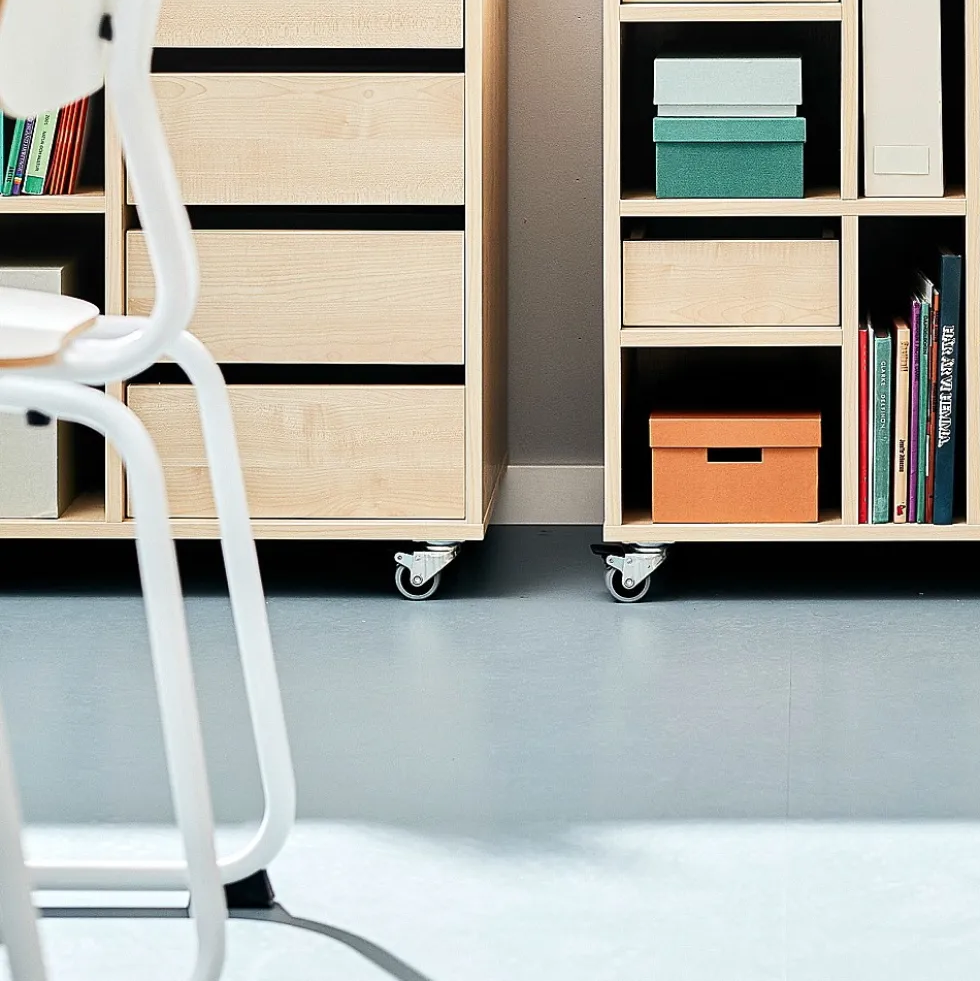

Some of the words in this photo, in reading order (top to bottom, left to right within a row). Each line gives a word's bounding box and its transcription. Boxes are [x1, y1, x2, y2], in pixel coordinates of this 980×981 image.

[942, 325, 956, 355] HÄR
[940, 356, 955, 376] ÄR
[937, 392, 952, 448] HEMMA
